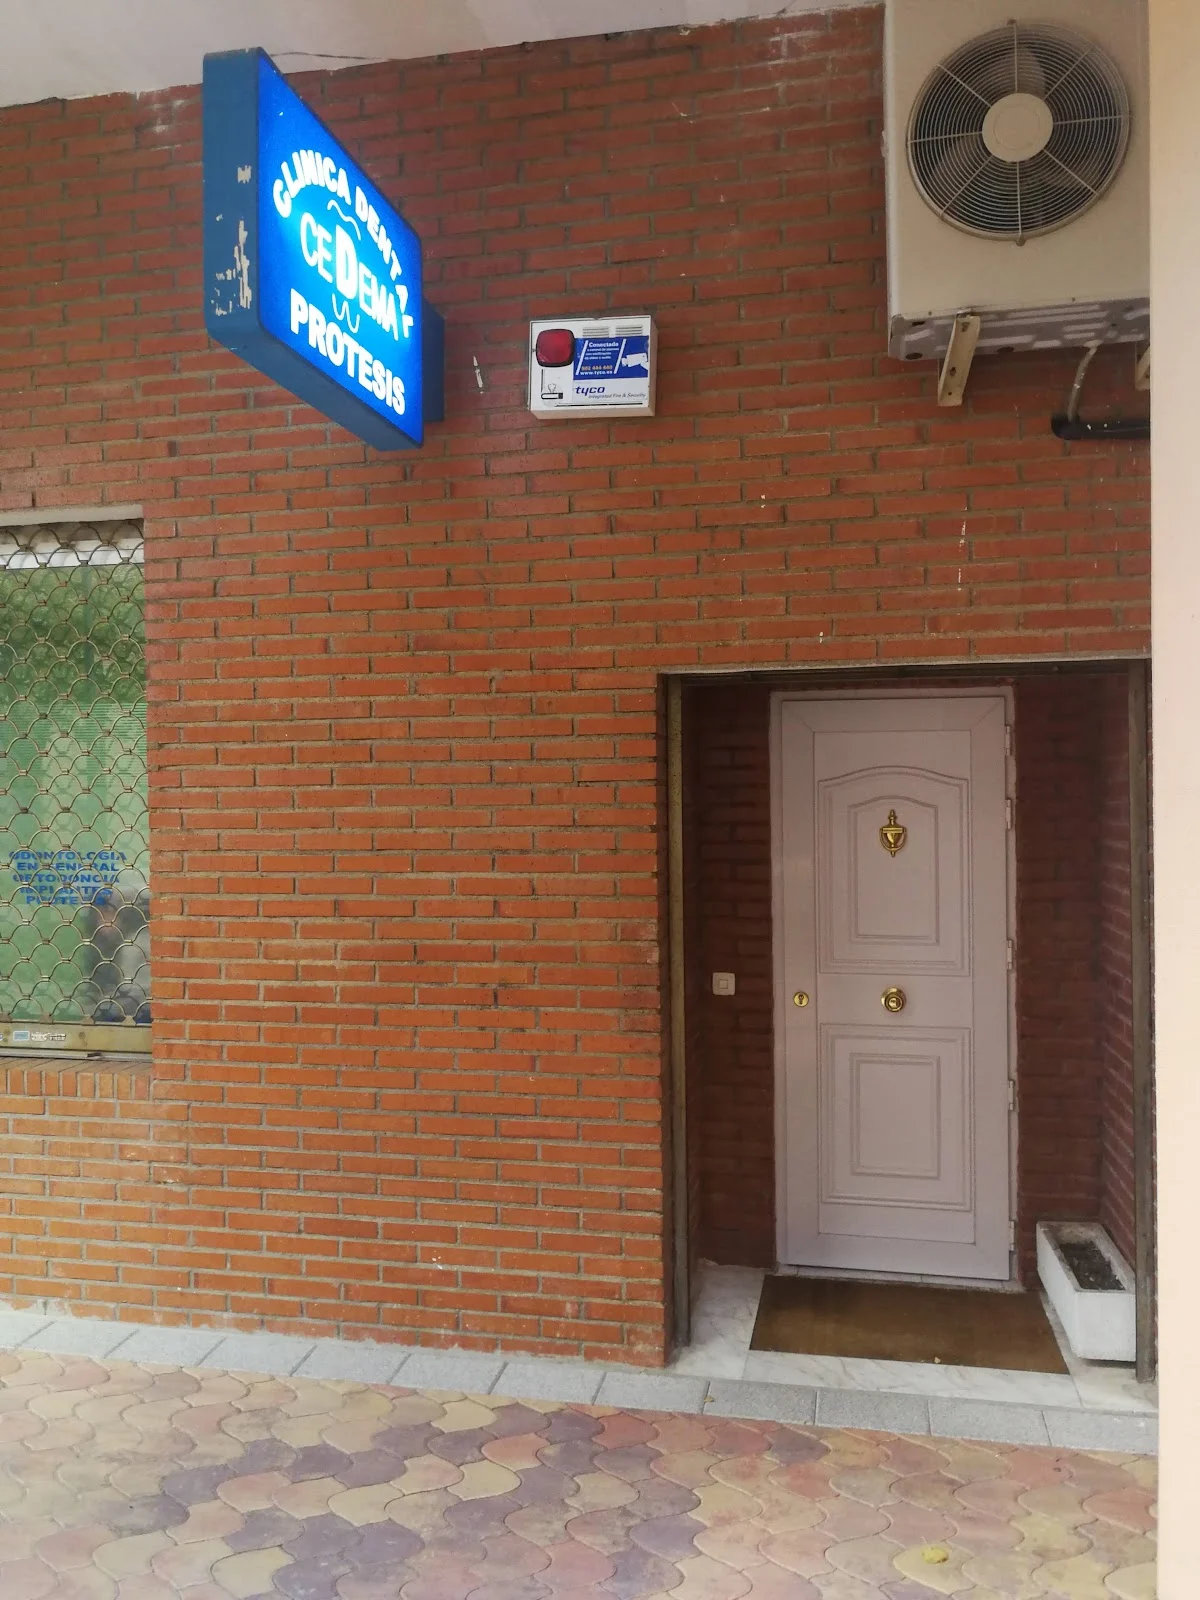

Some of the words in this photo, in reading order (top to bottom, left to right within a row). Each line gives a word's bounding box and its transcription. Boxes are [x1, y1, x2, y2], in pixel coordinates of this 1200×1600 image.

[273, 150, 352, 218] CLINICA
[355, 186, 414, 338] DENTAL
[300, 212, 399, 341] CEDEMA
[290, 288, 406, 415] PROTESIS
[575, 386, 605, 396] tyco
[16, 862, 38, 871] EN
